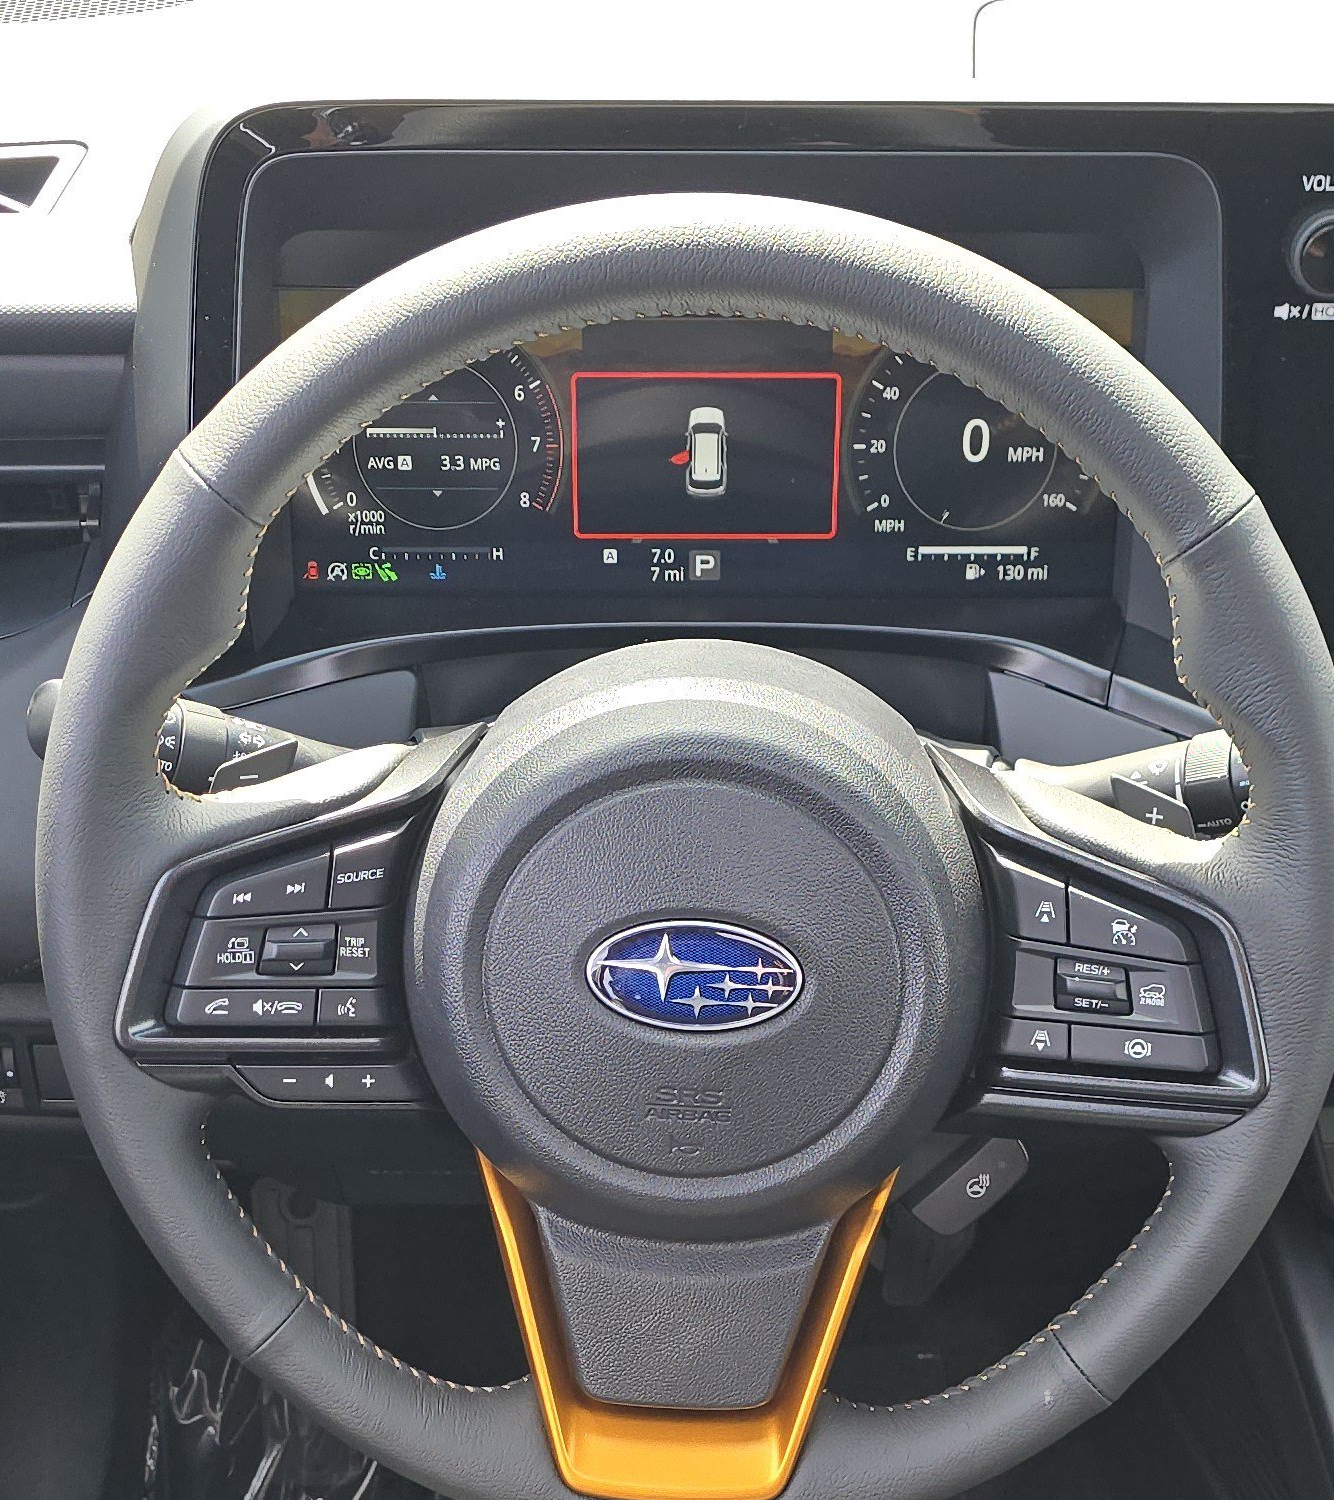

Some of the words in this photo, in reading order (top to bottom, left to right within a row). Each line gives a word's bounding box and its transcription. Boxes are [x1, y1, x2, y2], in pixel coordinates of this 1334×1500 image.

[514, 386, 525, 401] 6
[882, 387, 900, 401] 40
[530, 437, 541, 452] 7
[870, 440, 886, 453] 20
[962, 418, 990, 463] 0
[1007, 447, 1044, 463] MPH
[367, 457, 395, 470] AVG
[440, 456, 464, 471] 3.3
[469, 458, 501, 472] MPG
[346, 492, 357, 507] 0
[520, 493, 530, 508] 8
[880, 494, 889, 508] 0
[1042, 494, 1065, 508] 160
[348, 510, 385, 523] x1000
[349, 522, 386, 536] r/min
[874, 519, 905, 533] MPH
[369, 547, 379, 560] C
[493, 548, 504, 560] H
[651, 548, 675, 564] 7.0
[906, 548, 915, 561] E
[1031, 548, 1040, 561] F
[695, 555, 714, 577] P
[996, 565, 1024, 581] 130
[1027, 565, 1048, 581] mi
[651, 567, 660, 582] 7
[664, 566, 685, 582] mi
[336, 868, 385, 884] SOURCE
[344, 937, 365, 947] TRIP
[217, 952, 243, 964] HOLD
[340, 947, 371, 958] RESET
[655, 1087, 725, 1106] SRS
[645, 1109, 733, 1124] AIRBAG
